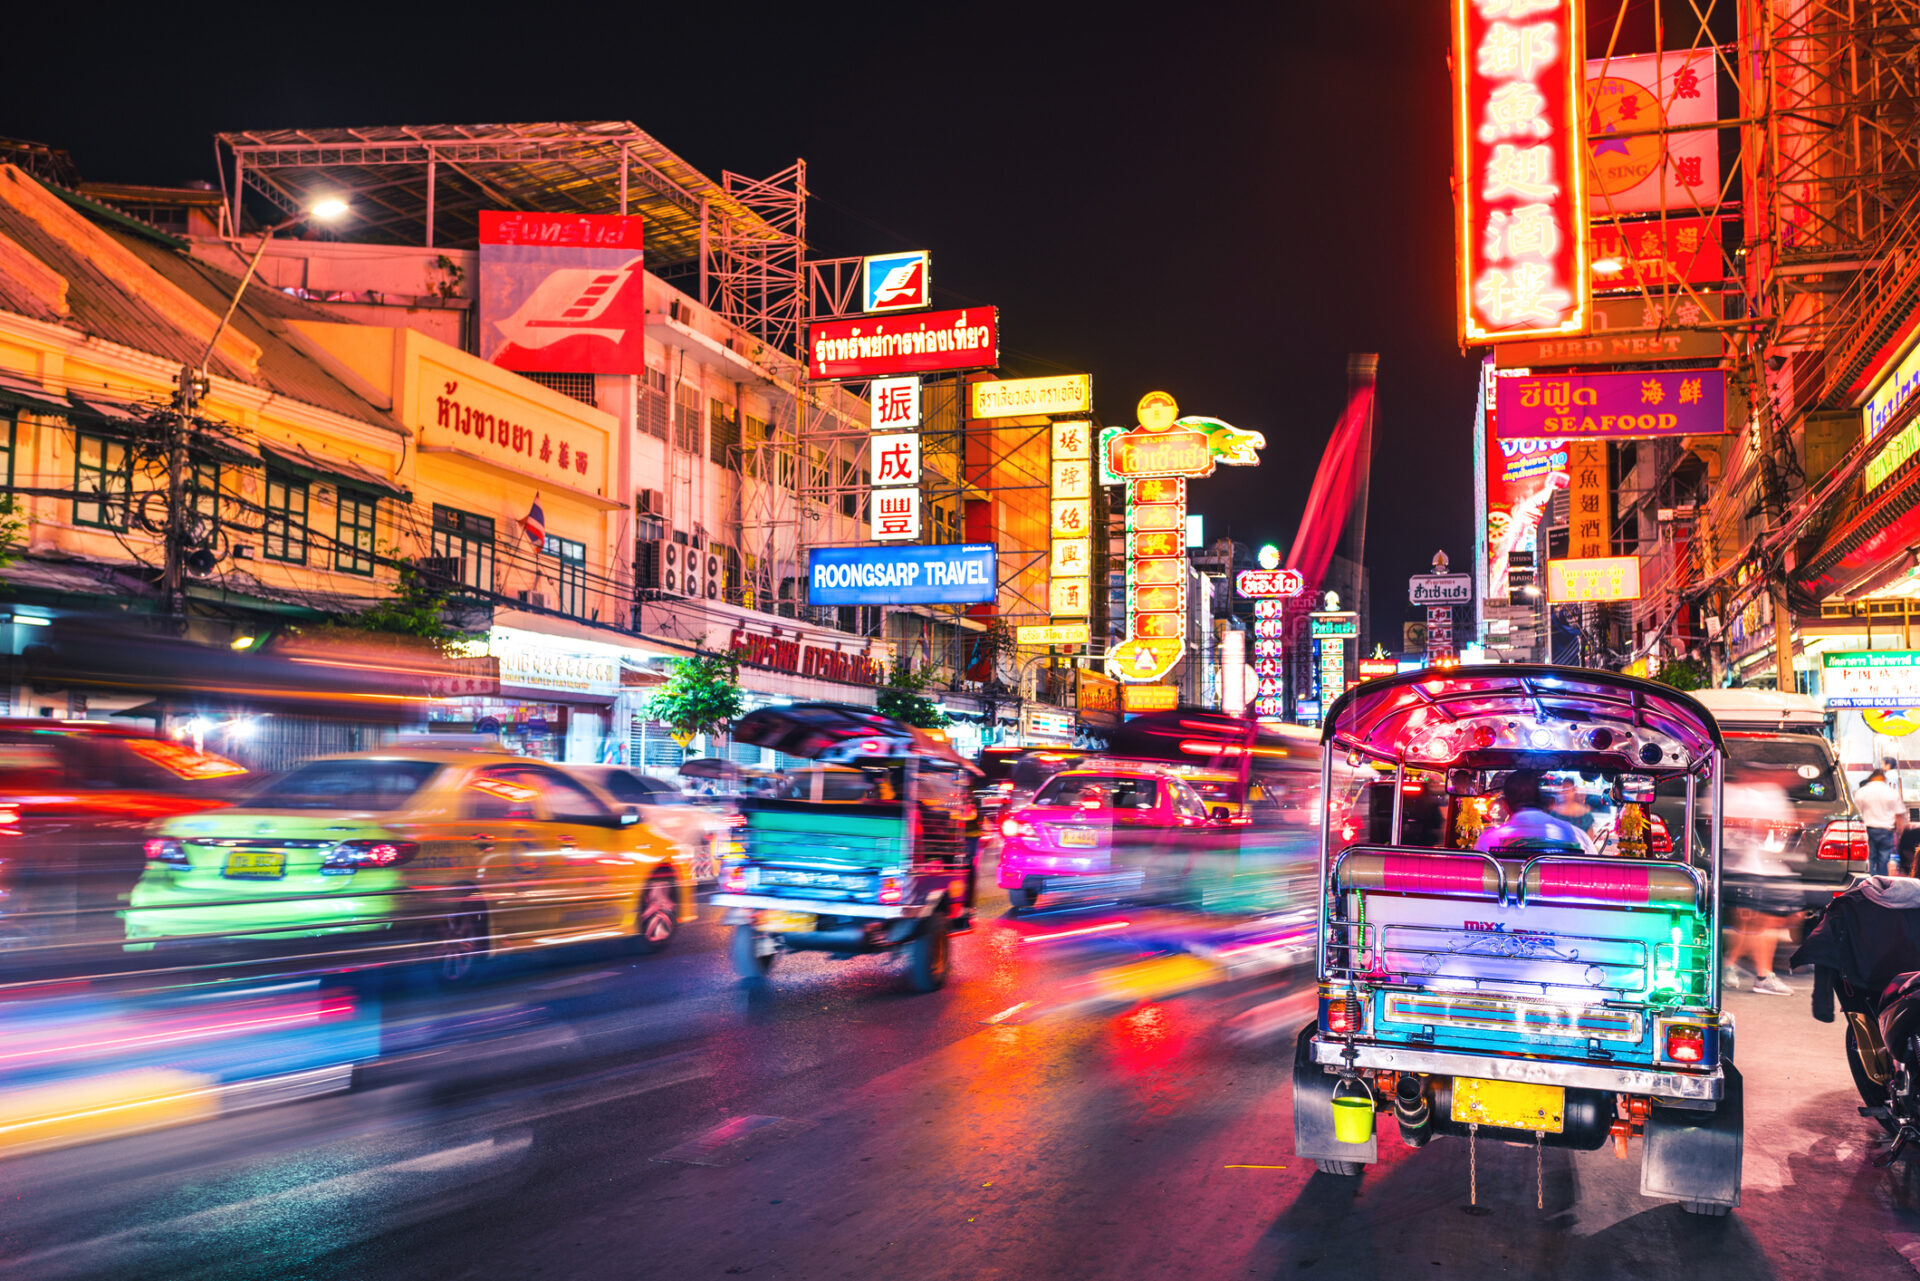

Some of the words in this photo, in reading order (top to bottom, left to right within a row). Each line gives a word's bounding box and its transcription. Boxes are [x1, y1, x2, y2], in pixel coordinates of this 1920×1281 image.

[1608, 164, 1648, 179] SING
[815, 310, 989, 374] รุ่งทรัพย์การท่องเที่ยว
[1539, 340, 1604, 360] BIRD
[1610, 336, 1681, 355] NEST
[1641, 377, 1703, 405] 海鮮
[437, 381, 532, 457] ห้างขายยา
[1544, 413, 1678, 432] SEAFOOD
[877, 385, 912, 535] 振成豐
[1868, 450, 1894, 489] CHINA
[814, 562, 919, 588] ROONGSARP
[923, 560, 988, 585] TRAVEL
